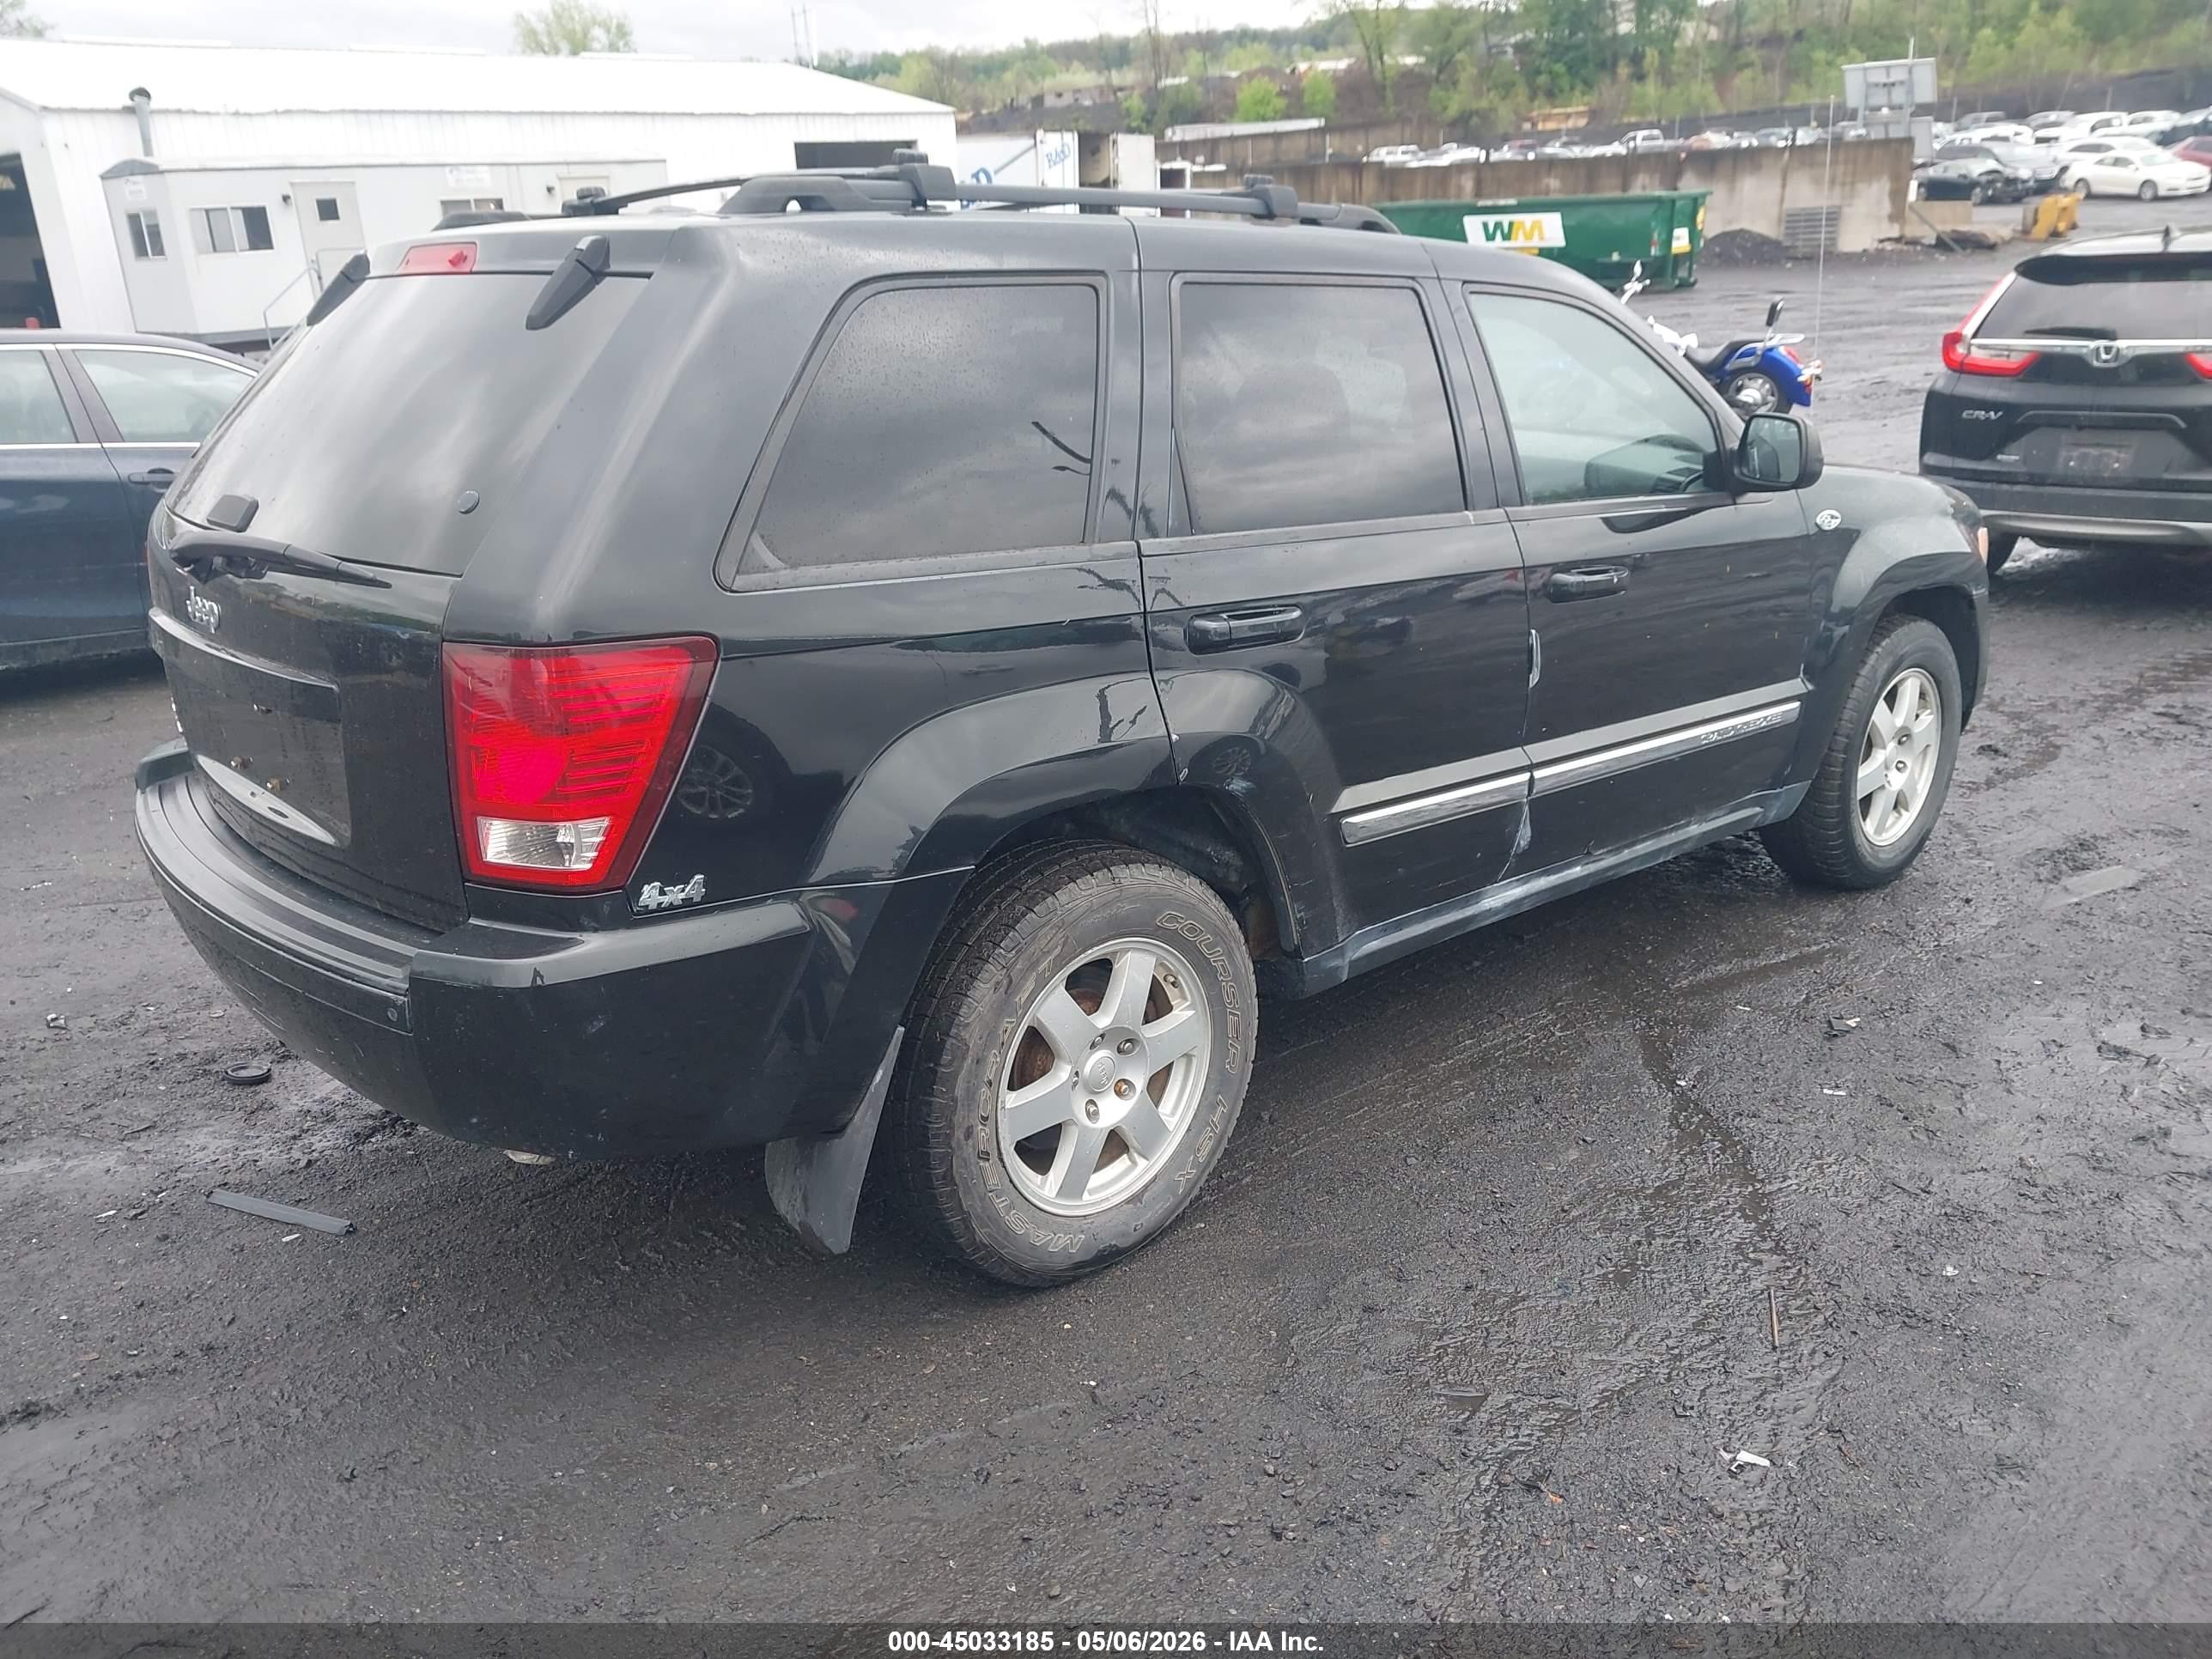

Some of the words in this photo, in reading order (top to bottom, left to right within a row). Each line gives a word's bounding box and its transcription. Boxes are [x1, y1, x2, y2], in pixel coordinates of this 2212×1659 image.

[1482, 220, 1544, 241] WM
[185, 586, 222, 634] Jeep
[638, 873, 706, 910] 4x4
[1156, 910, 1242, 1075] COURSER
[977, 943, 1085, 1253] MASTERCRAFT
[1174, 1094, 1229, 1195] HSX
